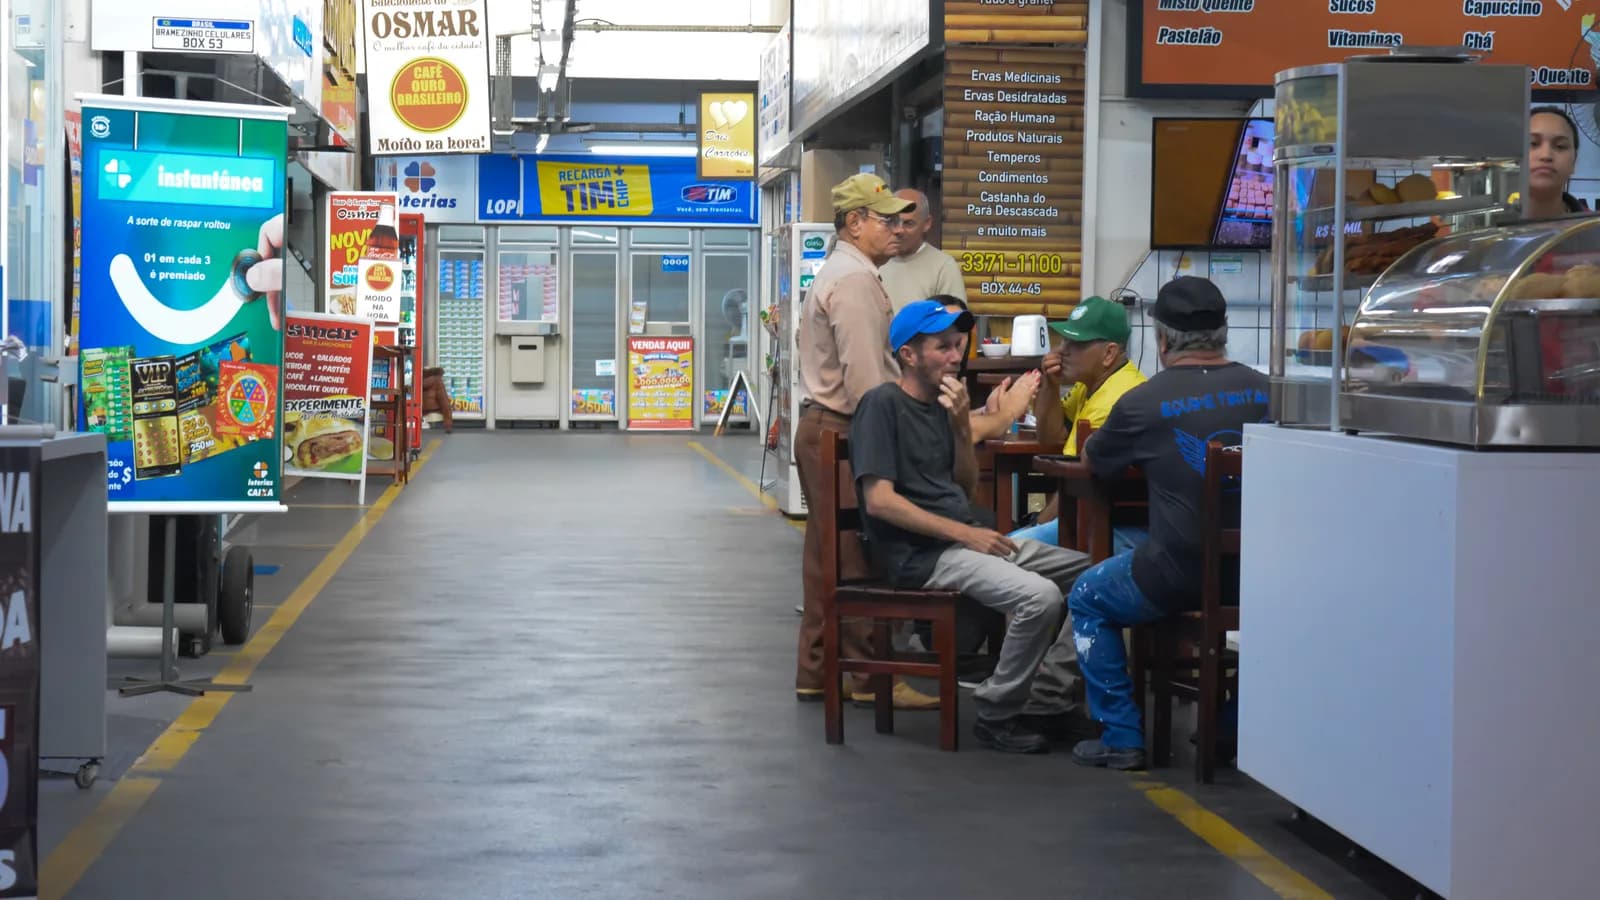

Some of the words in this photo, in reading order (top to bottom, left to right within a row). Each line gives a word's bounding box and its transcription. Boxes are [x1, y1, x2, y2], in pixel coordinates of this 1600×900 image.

[1330, 0, 1374, 12] Sucos
[1464, 0, 1541, 16] Capuccino
[192, 20, 215, 28] BRASIL
[372, 9, 479, 38] OSMAR
[156, 28, 204, 38] BRAMEZINHO
[204, 30, 251, 40] CELULARES
[1158, 28, 1221, 44] Pastelão
[1329, 31, 1402, 46] Vitaminas
[1464, 32, 1494, 50] Chá
[183, 38, 206, 48] BOX
[384, 42, 415, 52] melhor
[414, 64, 442, 78] CAFÉ
[972, 70, 1001, 82] Ervas
[1004, 72, 1061, 84] Medicinais
[1540, 68, 1590, 85] Quente
[412, 79, 446, 92] OURO
[397, 92, 461, 106] BRASILEIRO
[964, 90, 994, 101] Ervas
[998, 91, 1067, 104] Desidratadas
[975, 110, 1007, 124] Ração
[1010, 112, 1056, 124] Humana
[377, 138, 422, 152] Moído
[426, 140, 443, 150] na
[448, 136, 486, 150] hora!
[966, 130, 1014, 142] Produtos
[1017, 132, 1063, 144] Naturais
[987, 150, 1041, 165] Temperos
[157, 165, 264, 192] instantânea
[558, 168, 611, 181] RECARGA
[978, 170, 1048, 184] Condimentos
[560, 181, 615, 212] TIM
[616, 179, 630, 208] CHIP
[708, 188, 732, 200] TIM
[980, 192, 1030, 204] Castanha
[1033, 193, 1046, 204] do
[399, 194, 456, 208] terias
[968, 204, 992, 216] Pará
[996, 204, 1058, 217] Descascada
[127, 216, 134, 224] A
[136, 218, 159, 226] sorte
[160, 216, 172, 227] de
[174, 220, 202, 230] raspar
[204, 220, 230, 230] voltou
[978, 227, 984, 236] e
[988, 226, 1018, 236] muito
[1020, 226, 1047, 237] mais
[144, 252, 156, 262] 01
[160, 255, 174, 264] em
[177, 254, 202, 264] cada
[204, 256, 211, 264] 3
[962, 252, 1062, 274] 3371-1100
[150, 268, 156, 278] é
[159, 268, 206, 280] premiado
[981, 282, 1006, 294] BOX
[1008, 283, 1041, 294] 44-45
[1038, 326, 1046, 348] 6
[632, 341, 665, 350] VENDAS
[136, 362, 170, 383] VIP
[286, 362, 312, 370] EBIDAS
[286, 372, 304, 380] CAFÉ
[286, 398, 362, 410] EXPERIMENTE
[108, 458, 124, 467] são
[122, 466, 132, 485] $
[247, 488, 274, 496] CAIXA
[0, 590, 31, 650] A
